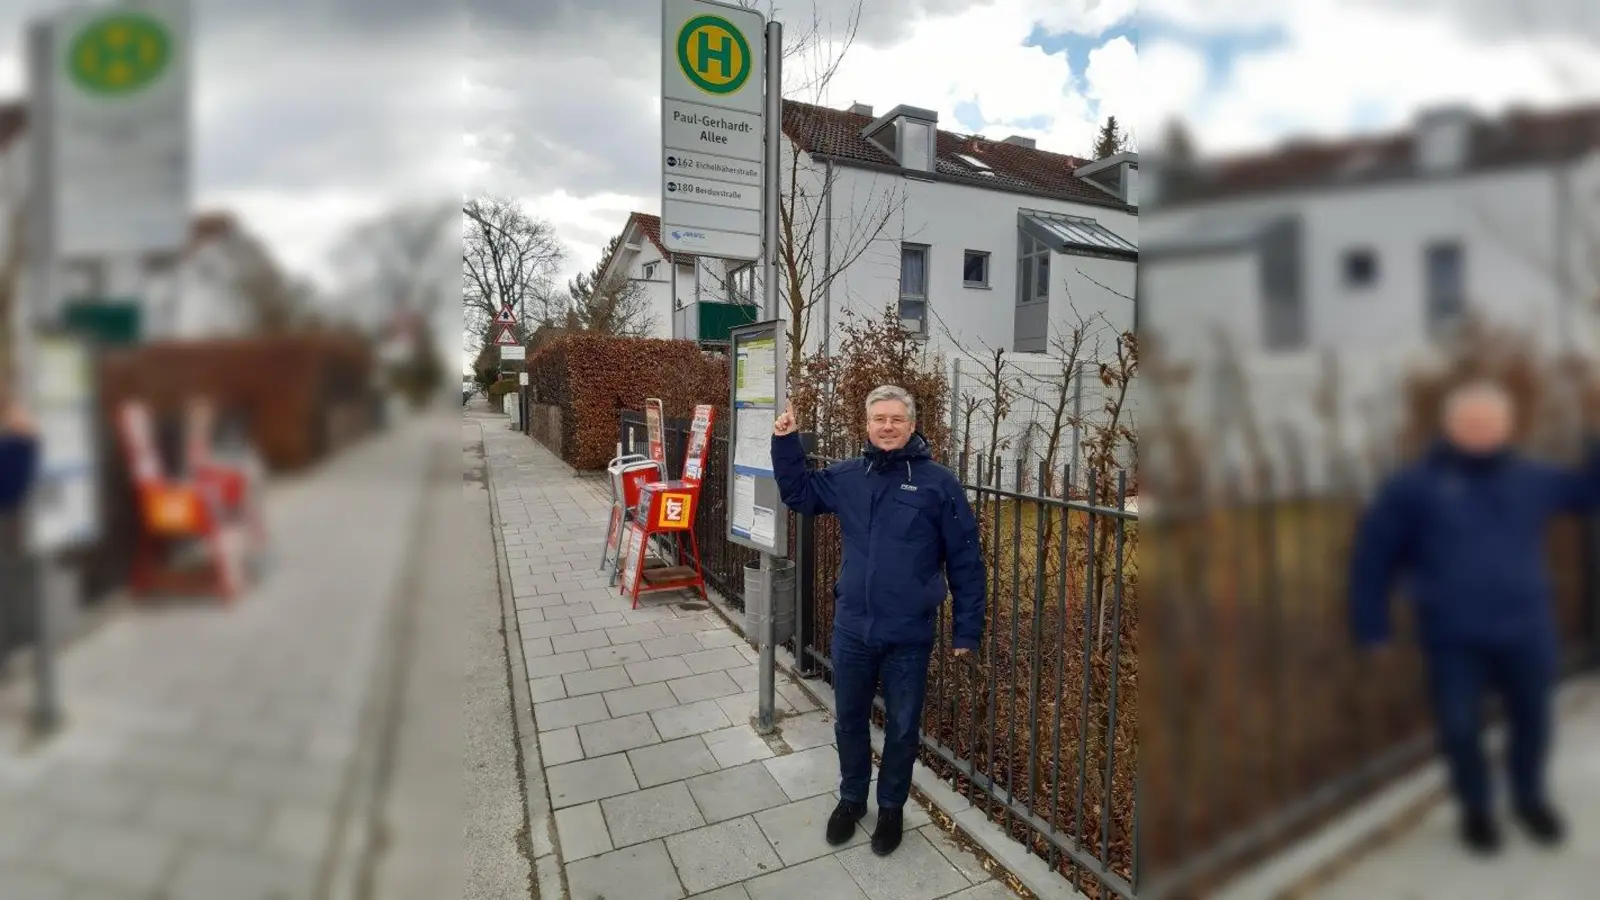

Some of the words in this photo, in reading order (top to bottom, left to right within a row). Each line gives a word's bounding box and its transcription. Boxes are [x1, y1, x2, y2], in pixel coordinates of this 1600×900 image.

[698, 31, 731, 78] H
[673, 110, 753, 133] Paul-Gerhardt-
[699, 130, 728, 145] Allee
[677, 157, 694, 168] 162
[677, 182, 694, 193] 180
